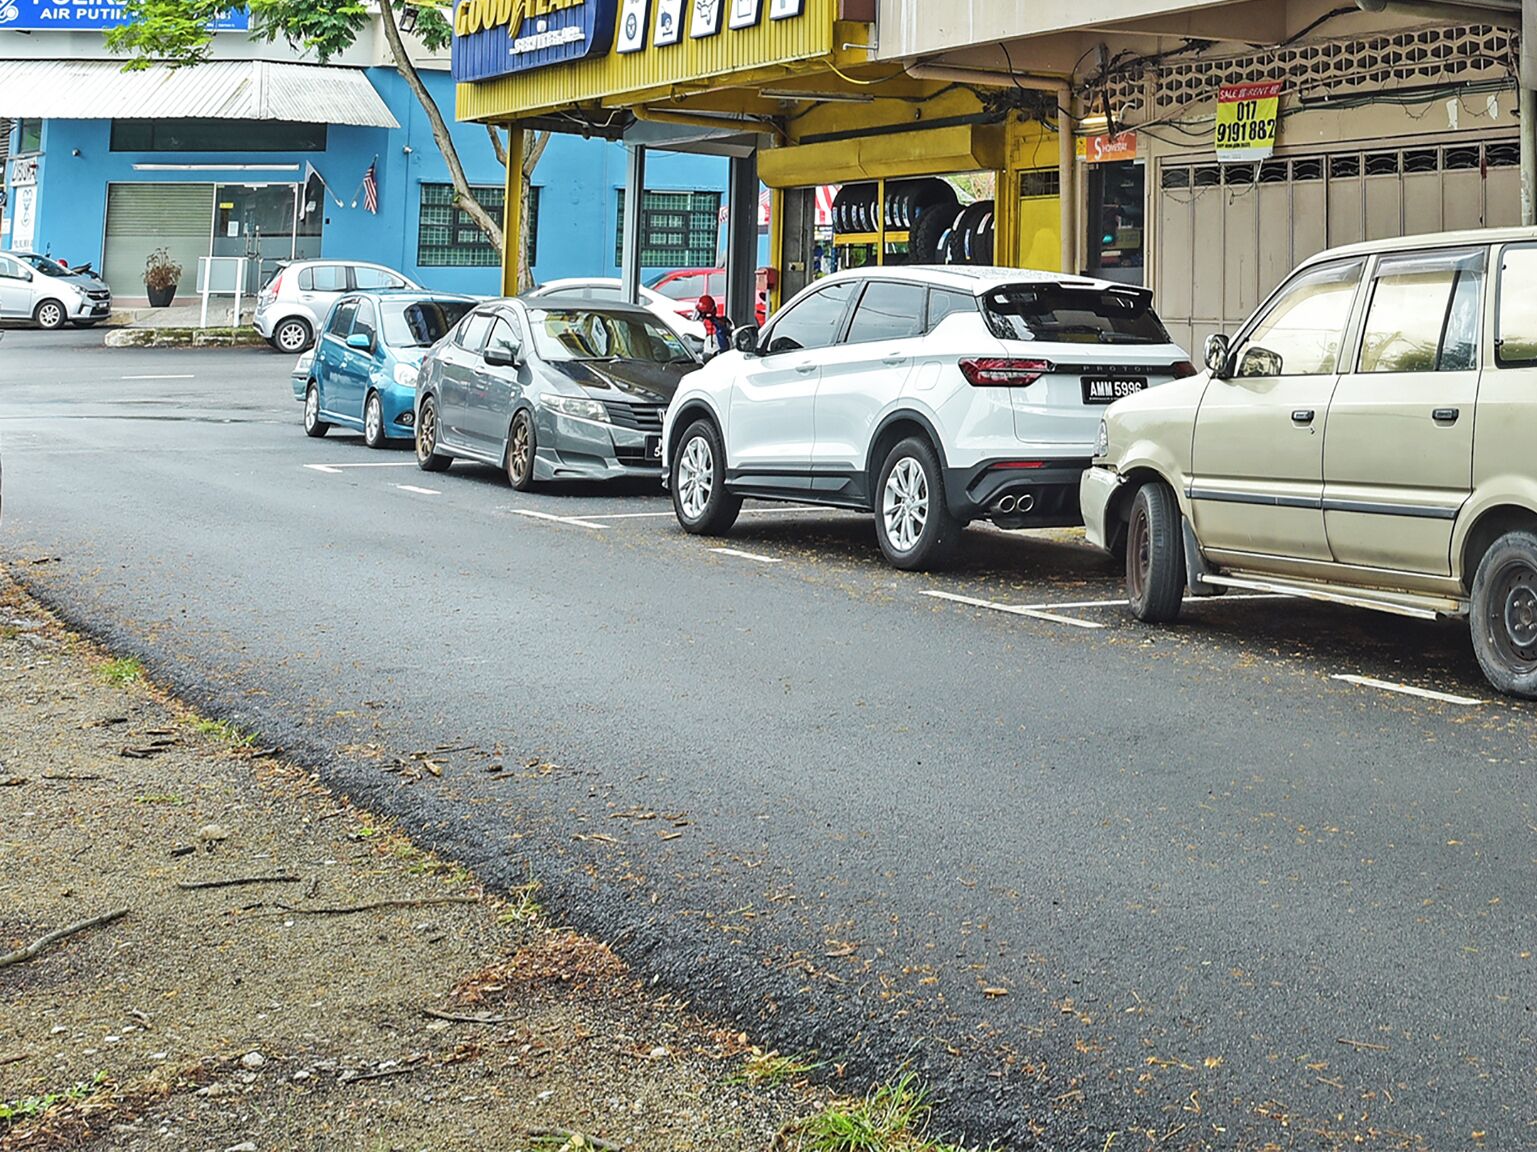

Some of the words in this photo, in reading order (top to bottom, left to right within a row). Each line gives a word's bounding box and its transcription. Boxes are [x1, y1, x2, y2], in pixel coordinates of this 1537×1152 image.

[40, 8, 70, 20] AIR
[1220, 89, 1238, 100] SALE
[1237, 100, 1257, 122] 017
[1090, 381, 1113, 397] AMM
[1115, 381, 1142, 397] 5996
